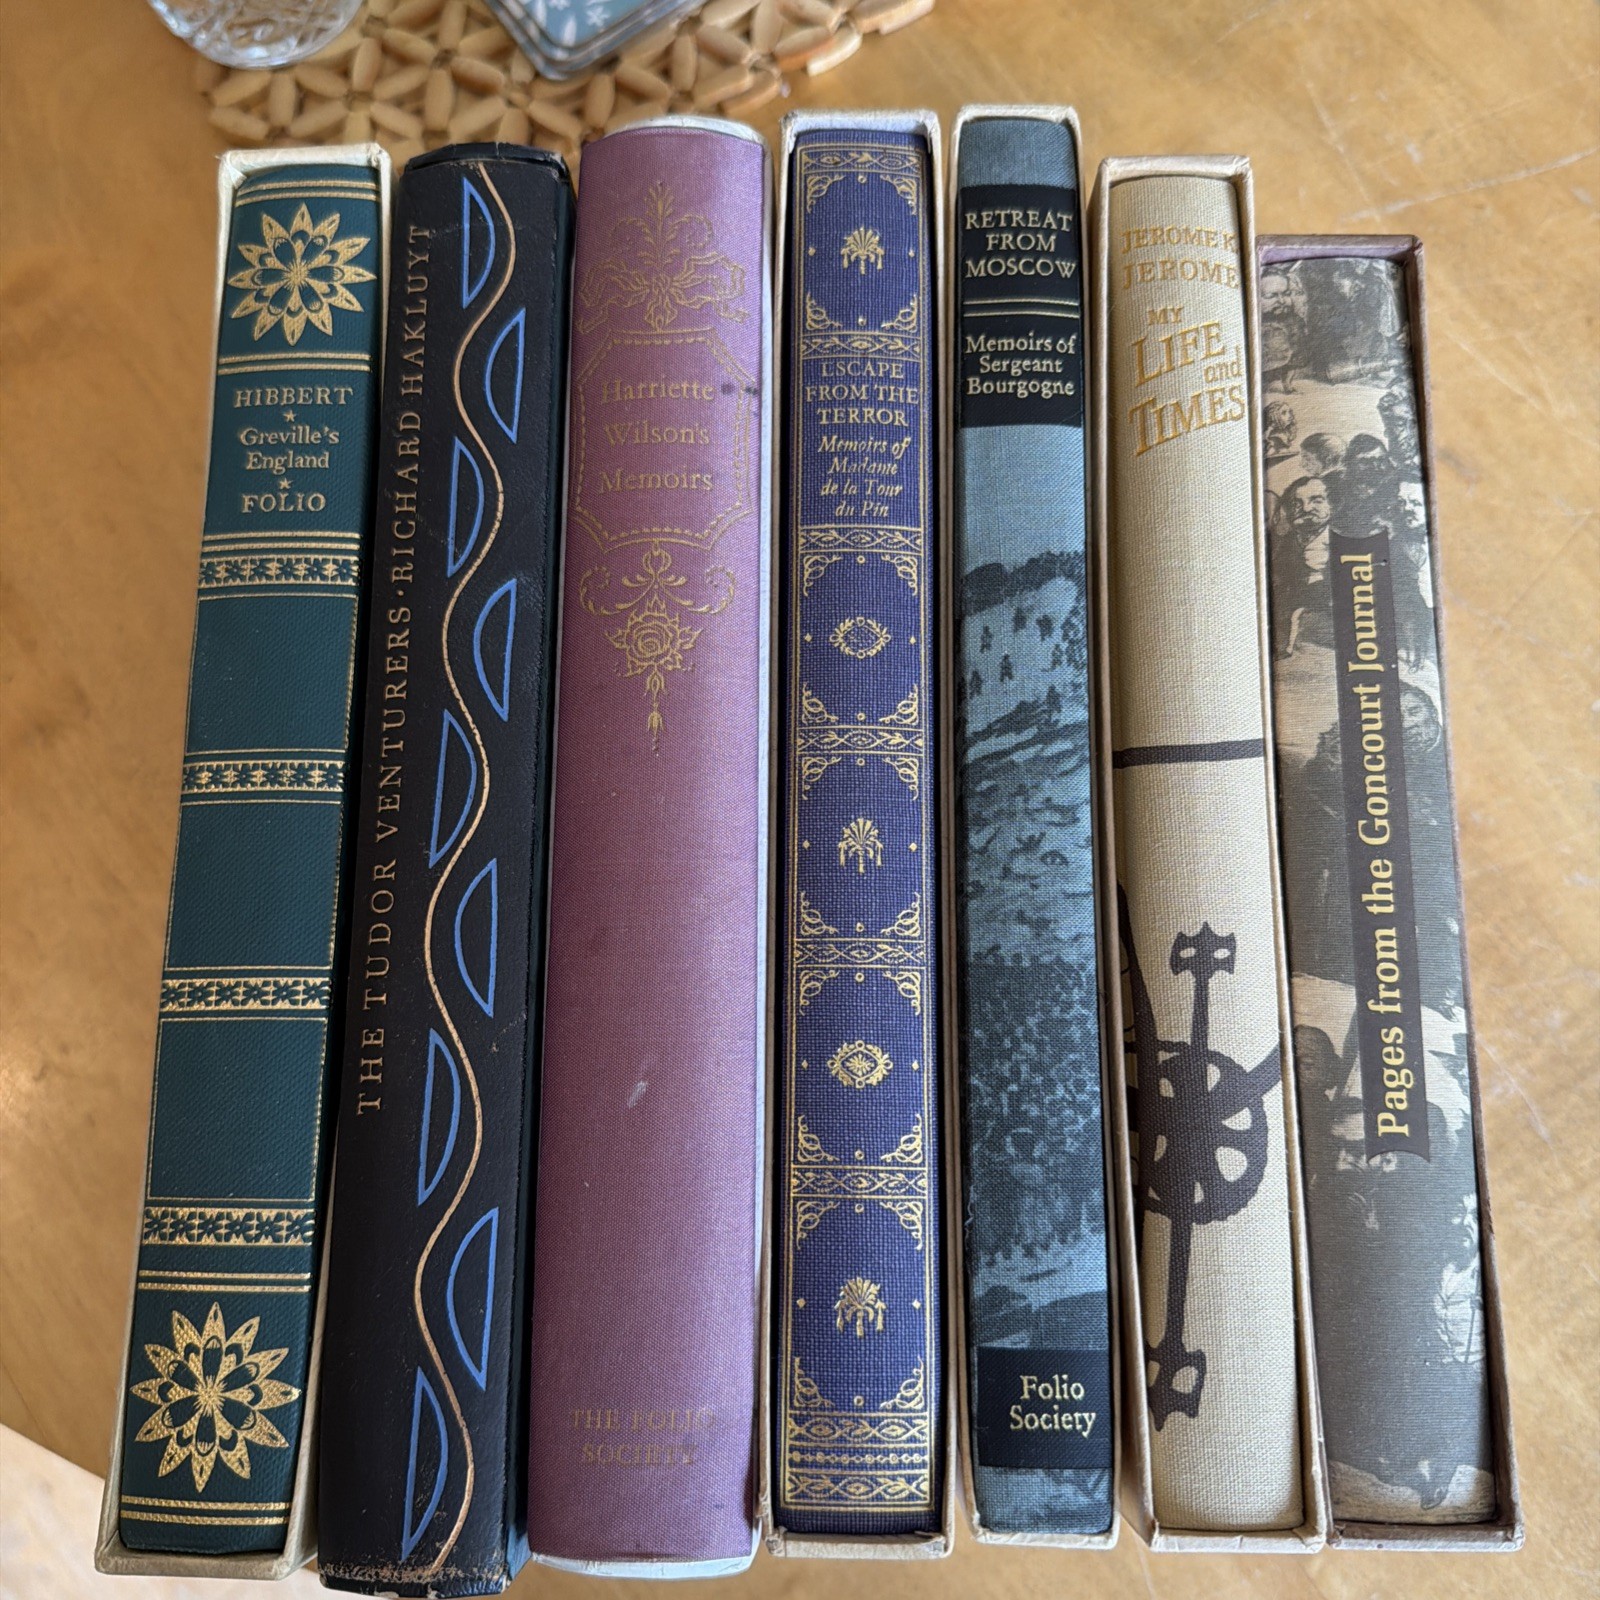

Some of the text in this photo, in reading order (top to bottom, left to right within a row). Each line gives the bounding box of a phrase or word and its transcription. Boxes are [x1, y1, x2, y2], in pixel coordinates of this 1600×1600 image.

[965, 209, 1073, 232] RETREAT
[986, 233, 1057, 252] FROM
[1121, 224, 1219, 254] JEROME
[965, 258, 1077, 279] MOSCOW
[1122, 258, 1240, 289] JEROME
[401, 225, 431, 397] HAKLUYT
[1148, 304, 1184, 325] MY
[965, 330, 1077, 354] Memoirs of
[1131, 320, 1225, 387] LIFE
[822, 361, 905, 379] ESCAPE
[979, 355, 1064, 376] Sergeant
[1203, 344, 1242, 384] and
[234, 387, 354, 409] HIBBERT
[601, 374, 716, 405] Harriette
[806, 384, 919, 404] FROM THE
[967, 377, 1076, 399] Bourgogne
[817, 407, 909, 427] TERROR
[1128, 385, 1246, 456] TIMES
[239, 425, 340, 446] Greville's
[604, 420, 711, 448] Wilson's
[818, 435, 912, 460] Memoirs of
[245, 450, 330, 475] England
[828, 457, 898, 475] Madame
[600, 466, 714, 493] Memoirs
[820, 479, 903, 497] de la Tour
[241, 493, 327, 513] FOLIO
[391, 411, 422, 584] RICHARD
[835, 501, 889, 517] du Pin
[1340, 552, 1414, 1138] Pages from the Goncourt Journal
[363, 859, 397, 1011] TUDOR
[356, 1026, 385, 1117] THE
[1019, 1374, 1085, 1400] Folio
[1009, 1404, 1097, 1438] Society
